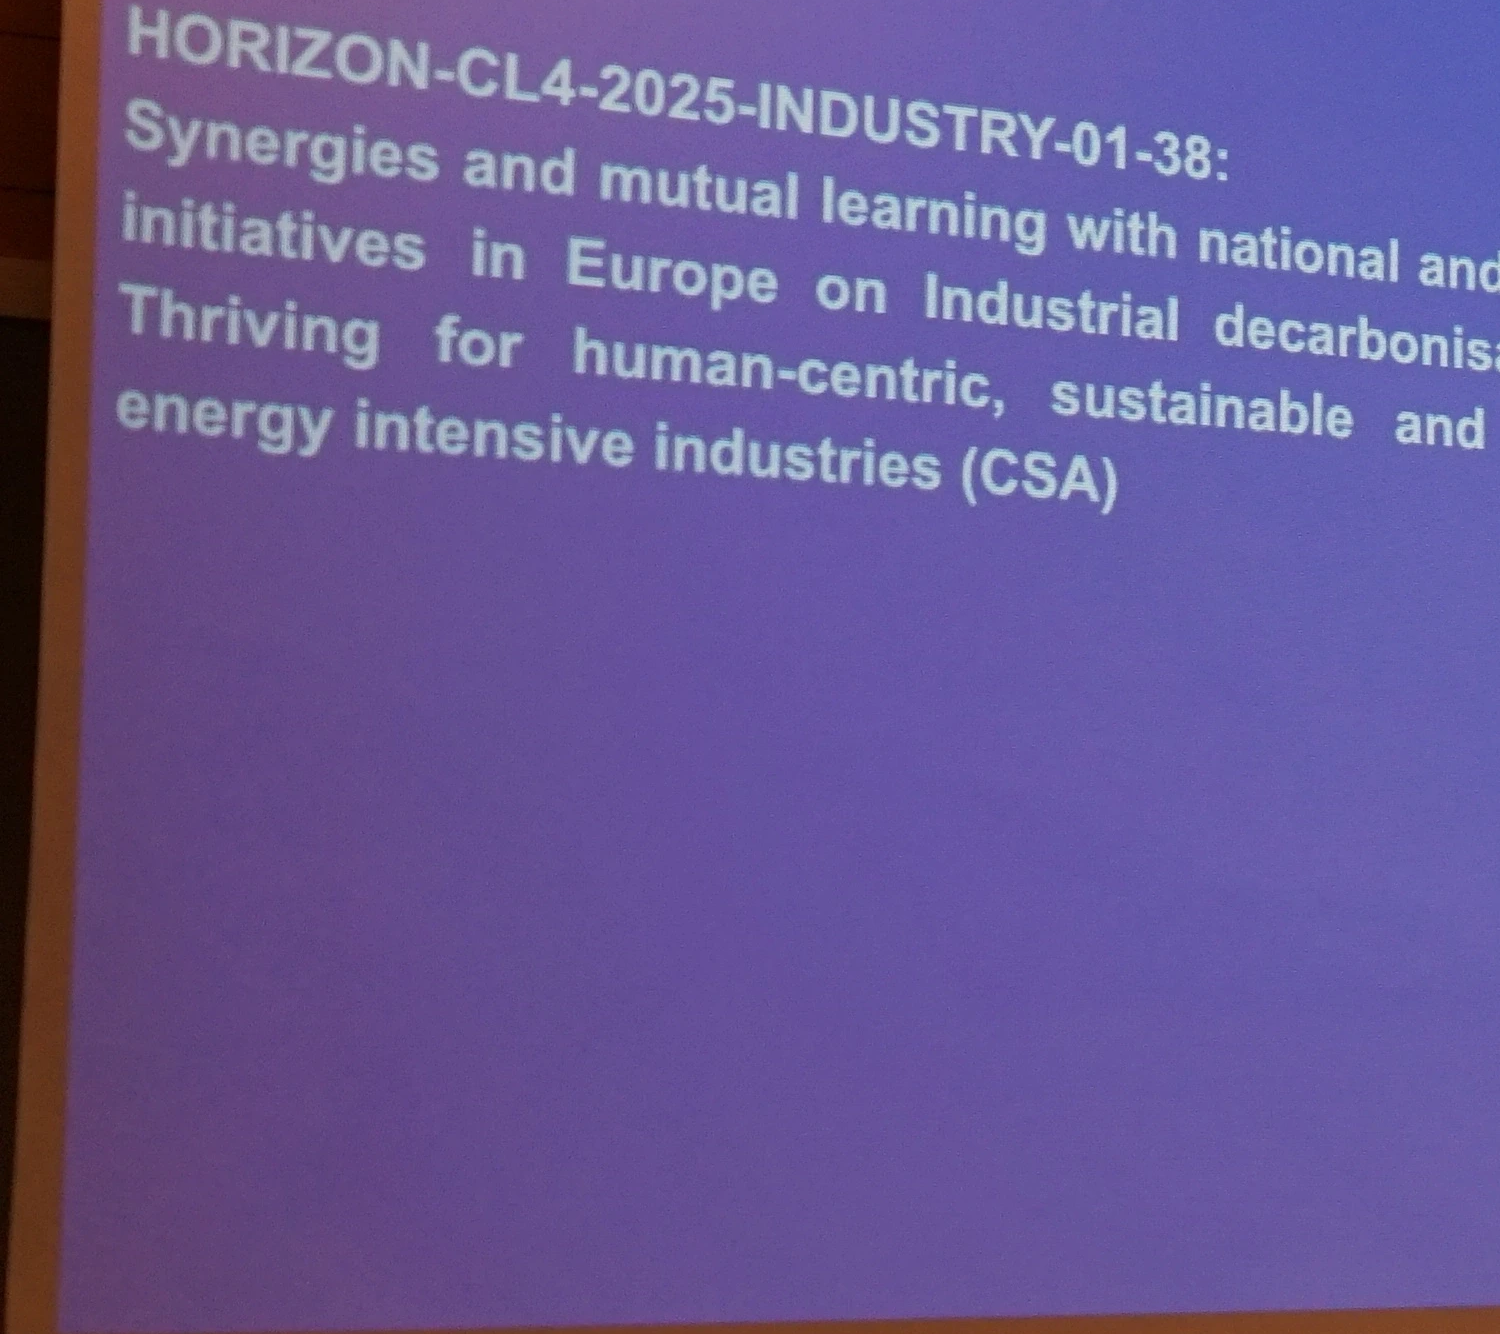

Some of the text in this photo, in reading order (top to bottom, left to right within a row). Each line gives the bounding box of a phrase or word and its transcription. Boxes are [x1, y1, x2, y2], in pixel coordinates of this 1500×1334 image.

[125, 5, 1230, 181] HORIZON-CL4-2025-INDUSTRY-01-38:
[122, 190, 426, 271] initiatives
[472, 227, 525, 280] in
[567, 237, 778, 311] Europe
[816, 275, 886, 314] on
[926, 272, 1179, 341] Industrial
[124, 98, 439, 184] Synergies
[464, 147, 575, 196] and
[600, 164, 798, 219] mutual
[823, 176, 1046, 256] learning
[1067, 208, 1177, 259] with
[1199, 226, 1399, 282] national
[118, 282, 379, 370] Thriving
[435, 314, 524, 368] for
[574, 326, 1004, 418] human-centric,
[1052, 381, 1354, 439] sustainable
[1395, 407, 1485, 450] and
[115, 389, 1118, 515] energy intensive industries (CSA)
